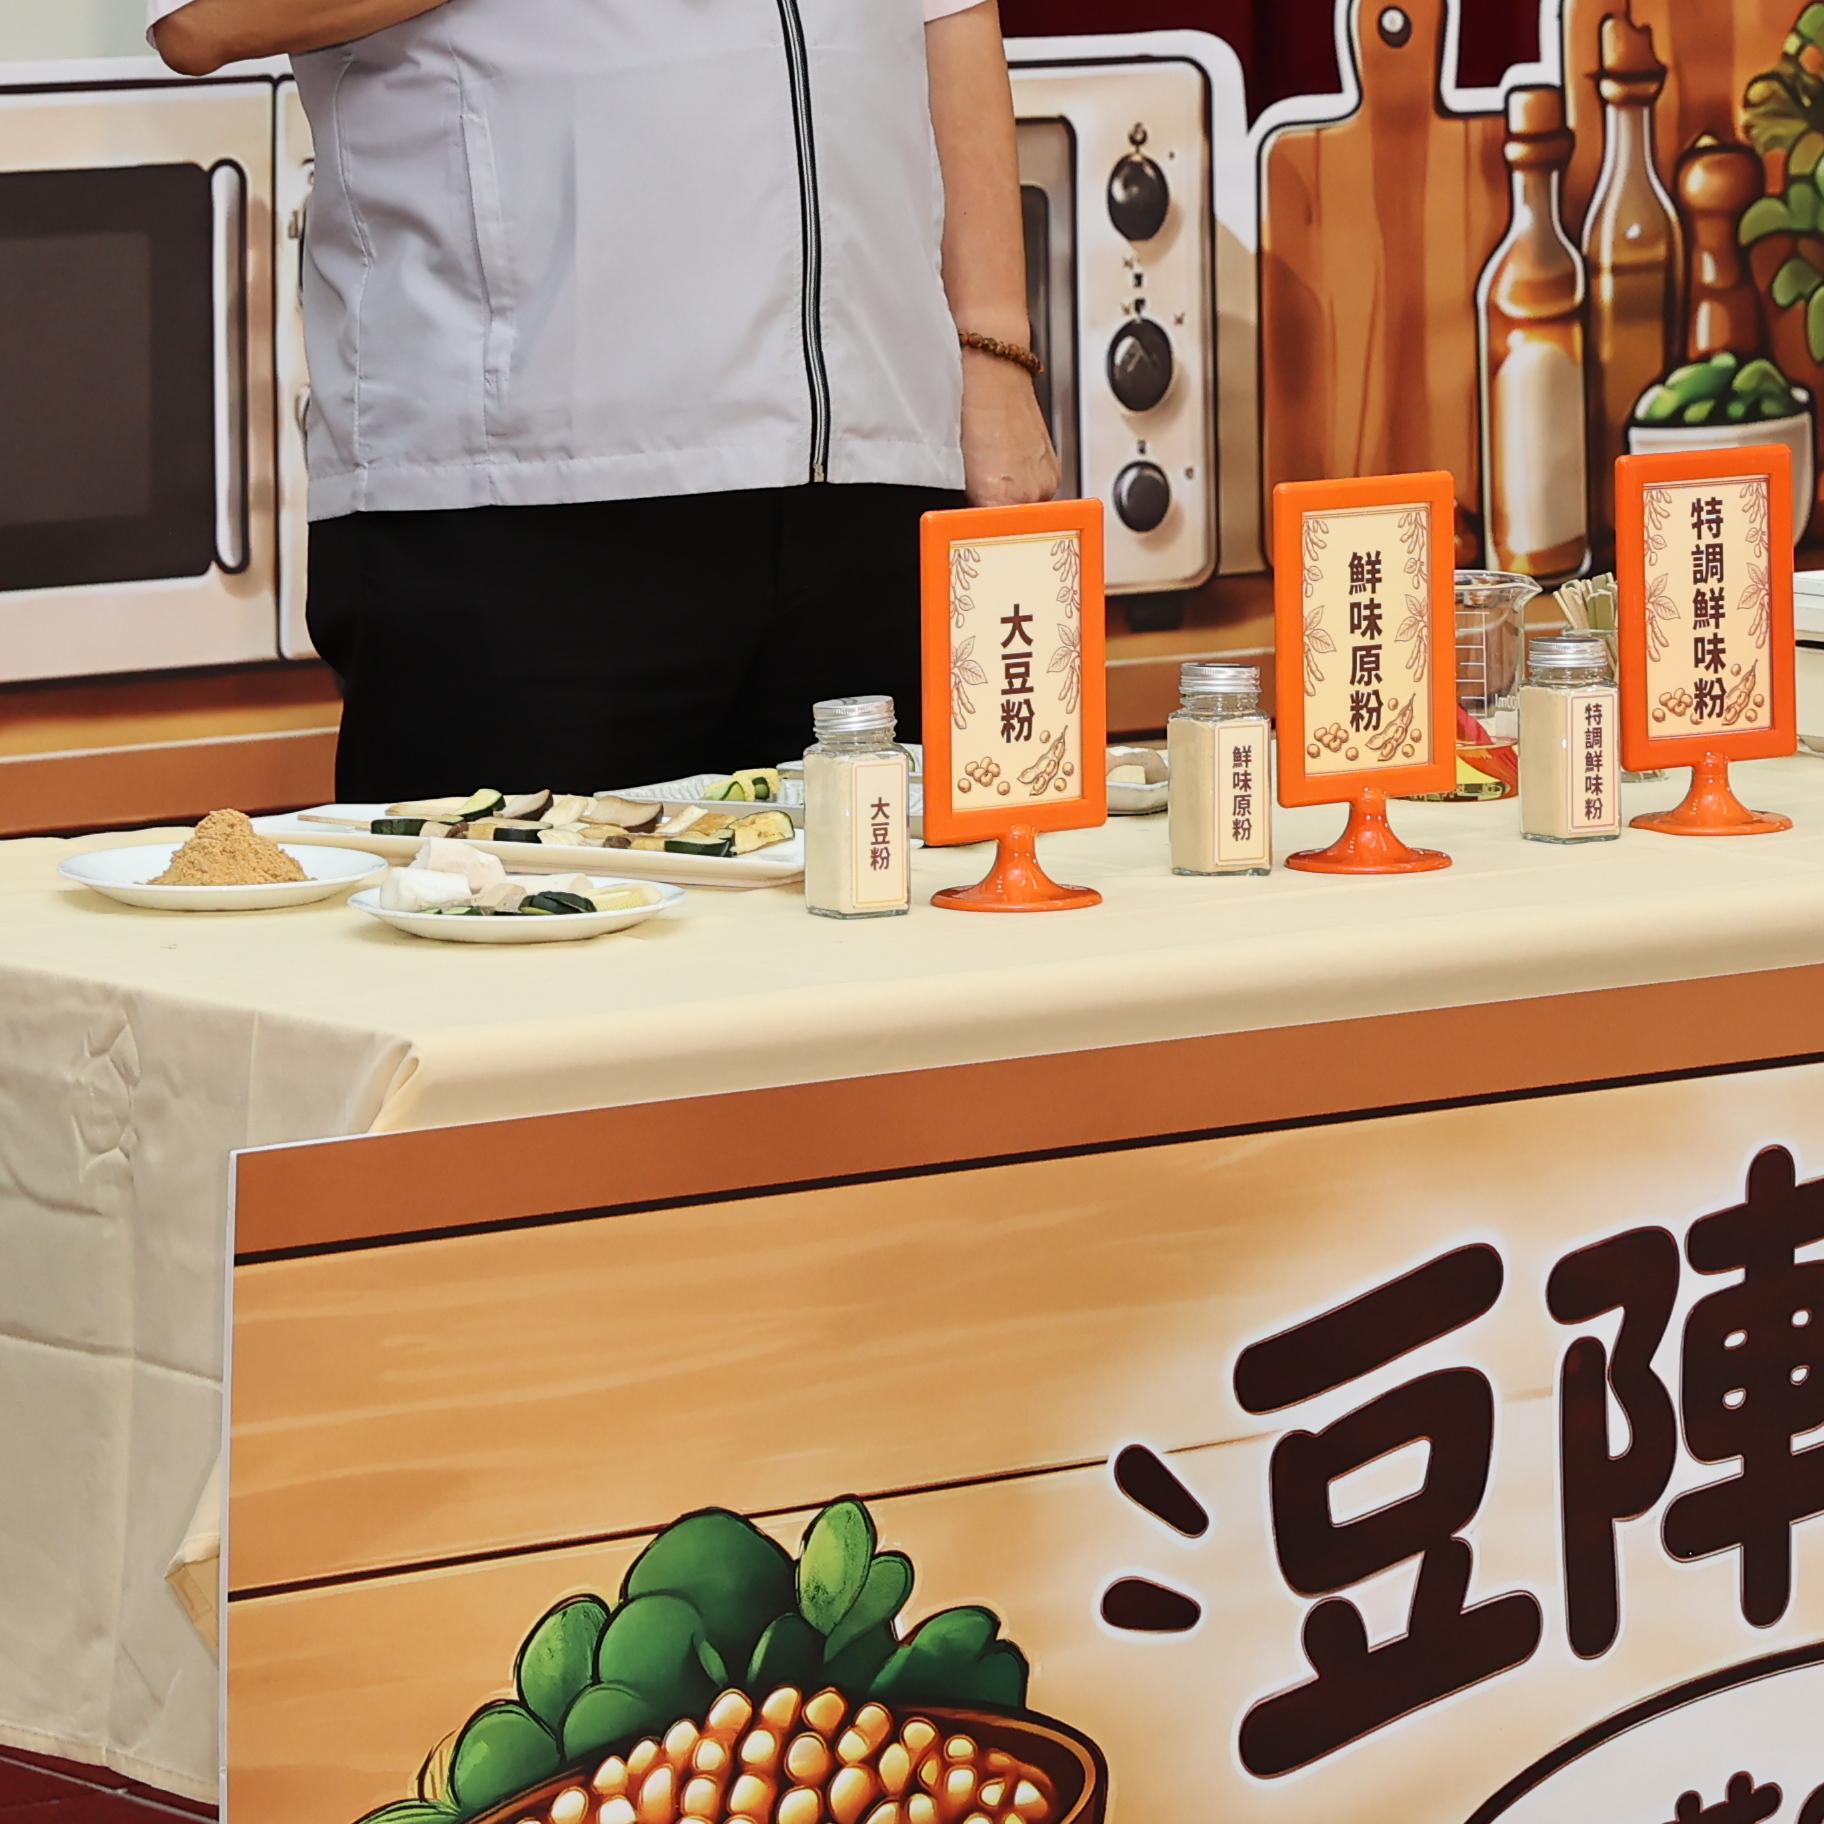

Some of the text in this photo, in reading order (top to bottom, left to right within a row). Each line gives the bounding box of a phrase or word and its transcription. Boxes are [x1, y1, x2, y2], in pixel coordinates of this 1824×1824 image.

[1348, 550, 1384, 733] 鮮味原粉
[1690, 496, 1726, 721] 特調鮮味粉
[1000, 603, 1035, 744] 大豆粉
[1232, 745, 1253, 842] 鮮味原粉
[1584, 703, 1604, 821] 特調鮮味粉
[870, 796, 891, 871] 大豆粉
